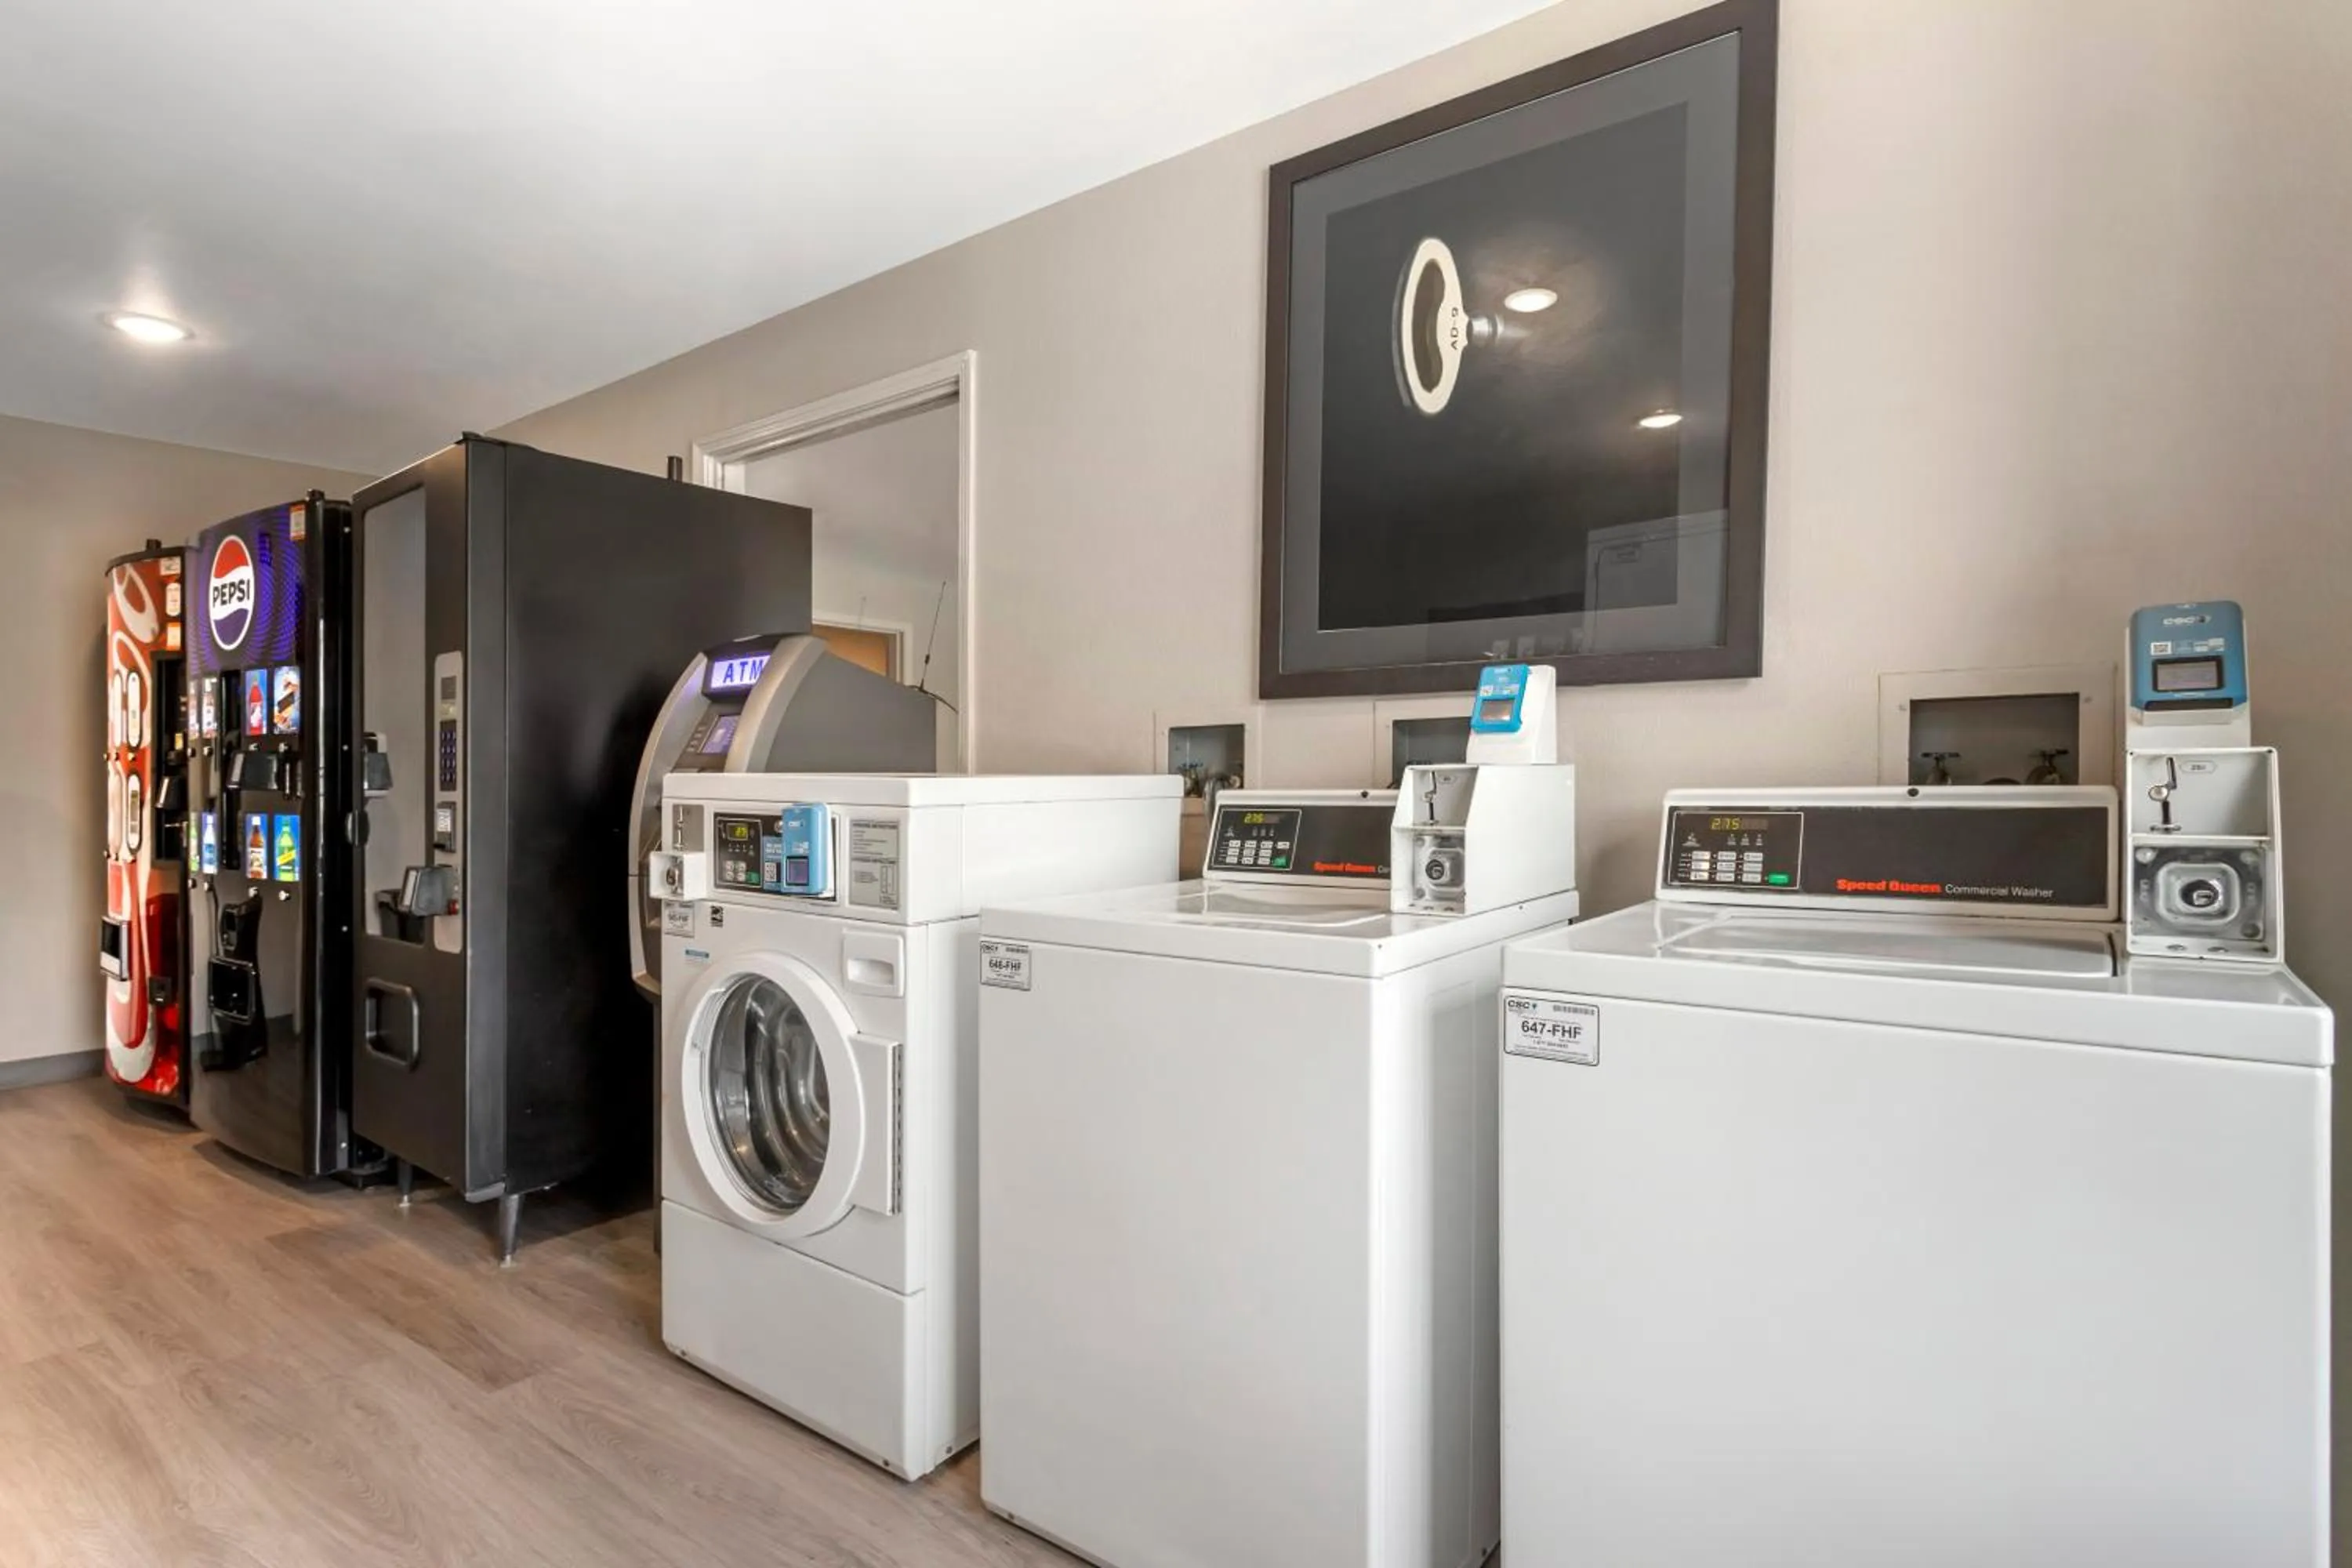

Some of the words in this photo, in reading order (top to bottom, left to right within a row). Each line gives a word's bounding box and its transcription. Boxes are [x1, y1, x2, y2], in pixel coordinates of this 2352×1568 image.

[212, 578, 250, 608] PEPSI
[723, 659, 764, 684] ATM
[1836, 878, 1886, 891] Speed
[1889, 880, 1941, 893] Queen
[1945, 884, 2009, 896] Commercial
[2011, 886, 2053, 898] Washer
[1521, 1020, 1582, 1039] 647-FHF
